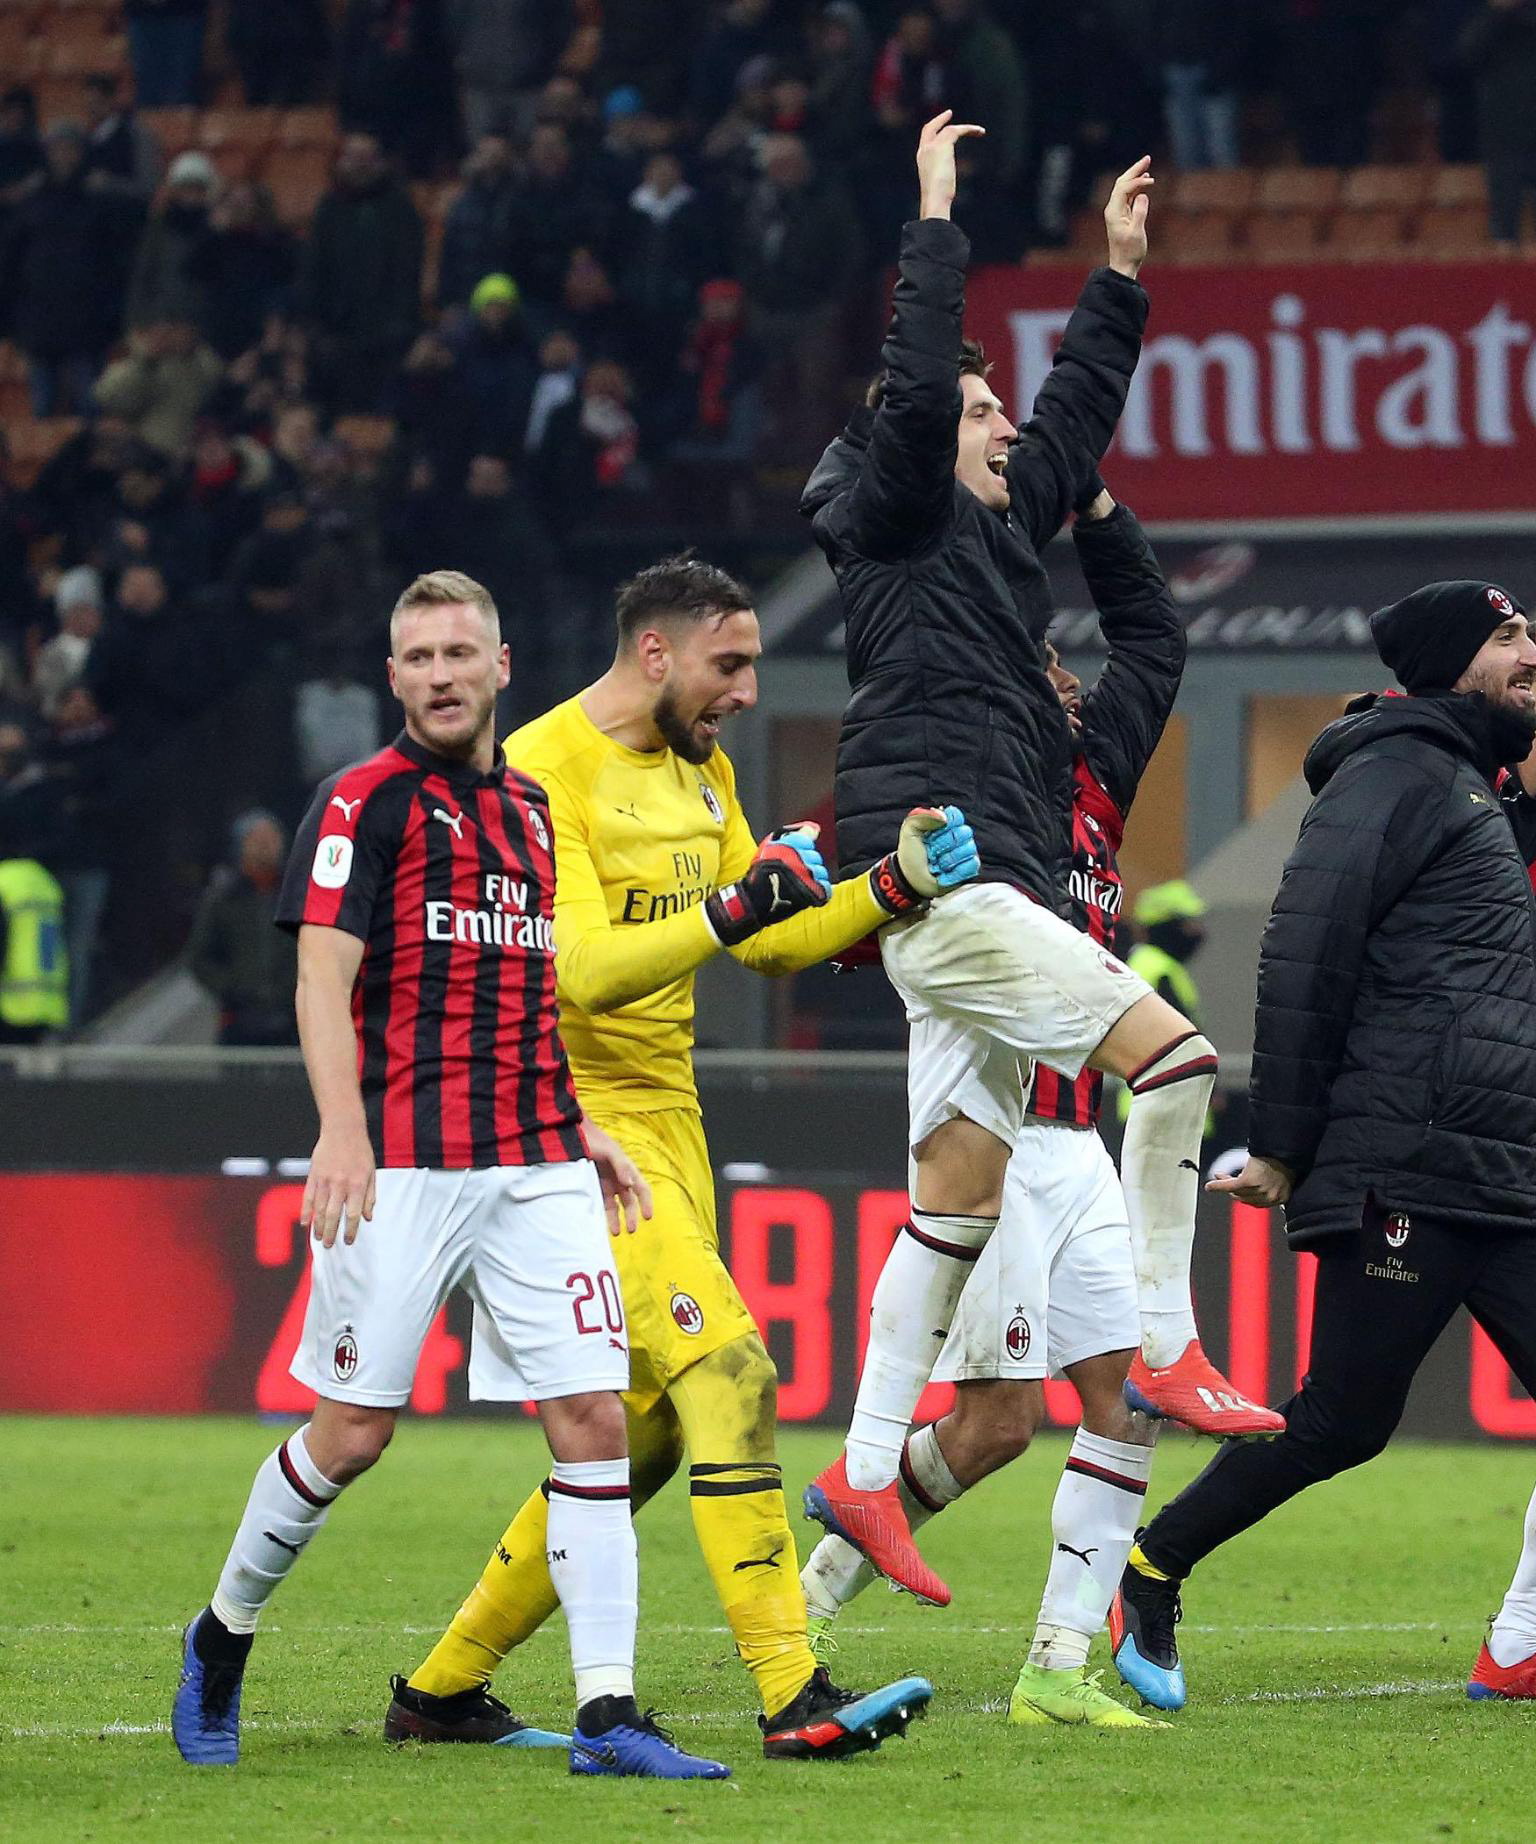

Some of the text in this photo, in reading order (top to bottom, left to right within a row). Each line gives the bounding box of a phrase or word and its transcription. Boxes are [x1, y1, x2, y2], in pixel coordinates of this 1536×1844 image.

[673, 851, 702, 881] Fly
[485, 873, 528, 912] Fly
[425, 901, 557, 953] Emirate
[1365, 1262, 1421, 1284] Emirates
[1386, 1256, 1403, 1270] Fly
[566, 1270, 624, 1336] 20
